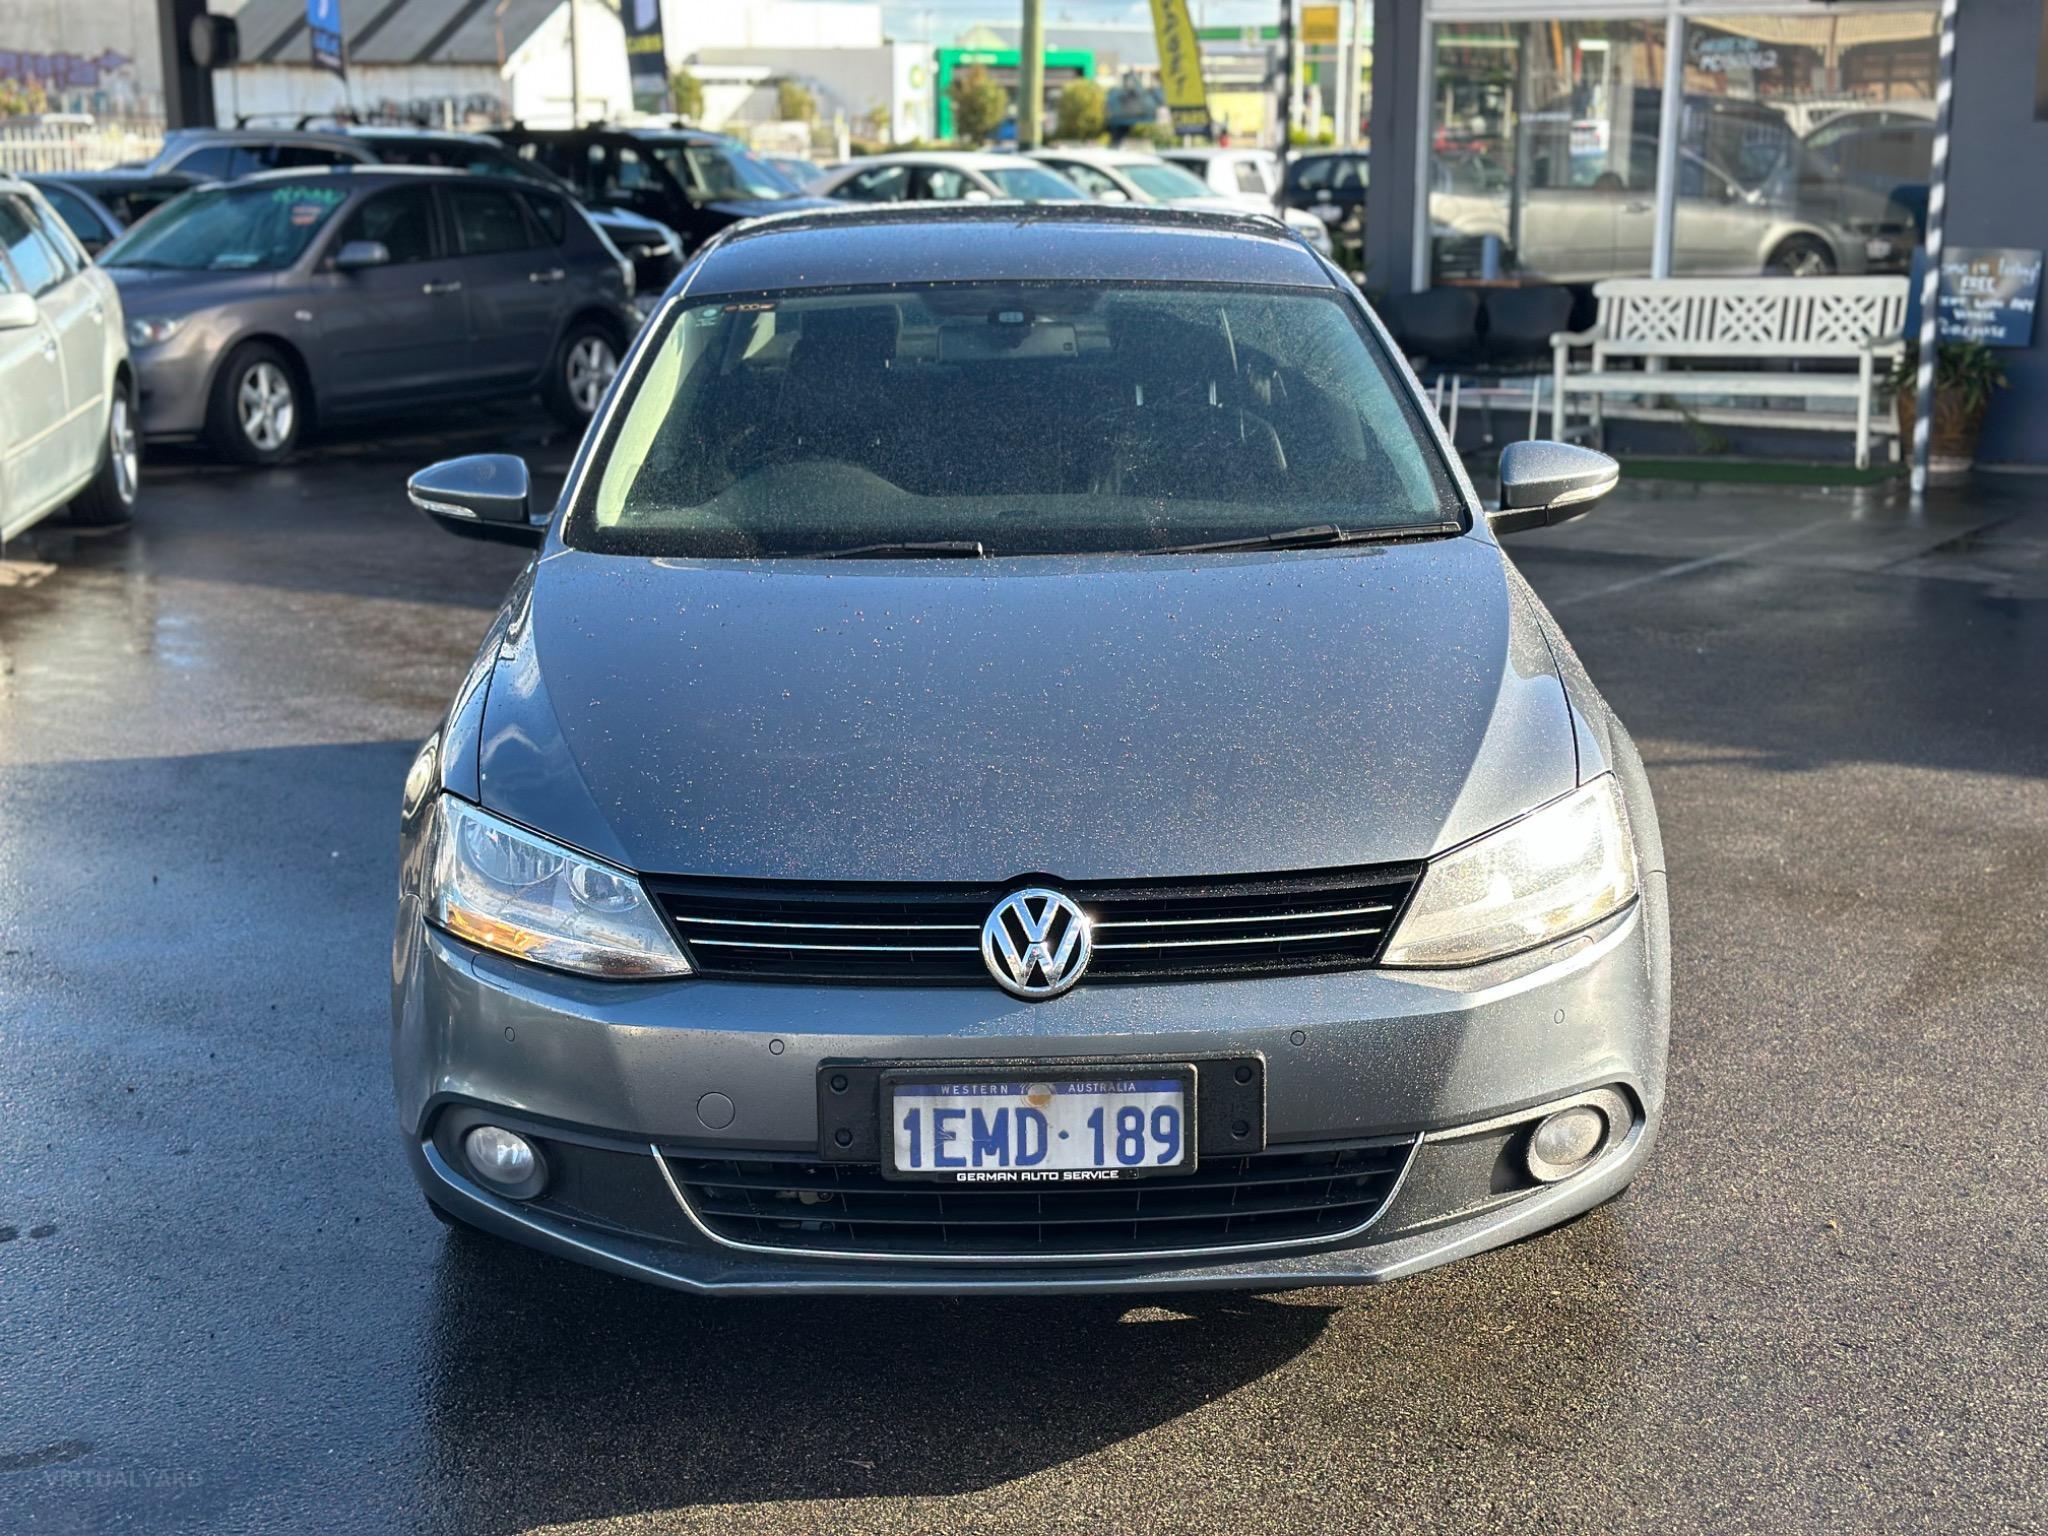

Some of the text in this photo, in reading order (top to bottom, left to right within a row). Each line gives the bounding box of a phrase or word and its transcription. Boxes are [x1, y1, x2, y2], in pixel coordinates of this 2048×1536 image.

[941, 1082, 1137, 1095] WESTERN AUSTRALIA
[956, 1169, 1119, 1182] GERMAN AUTO SERVICE
